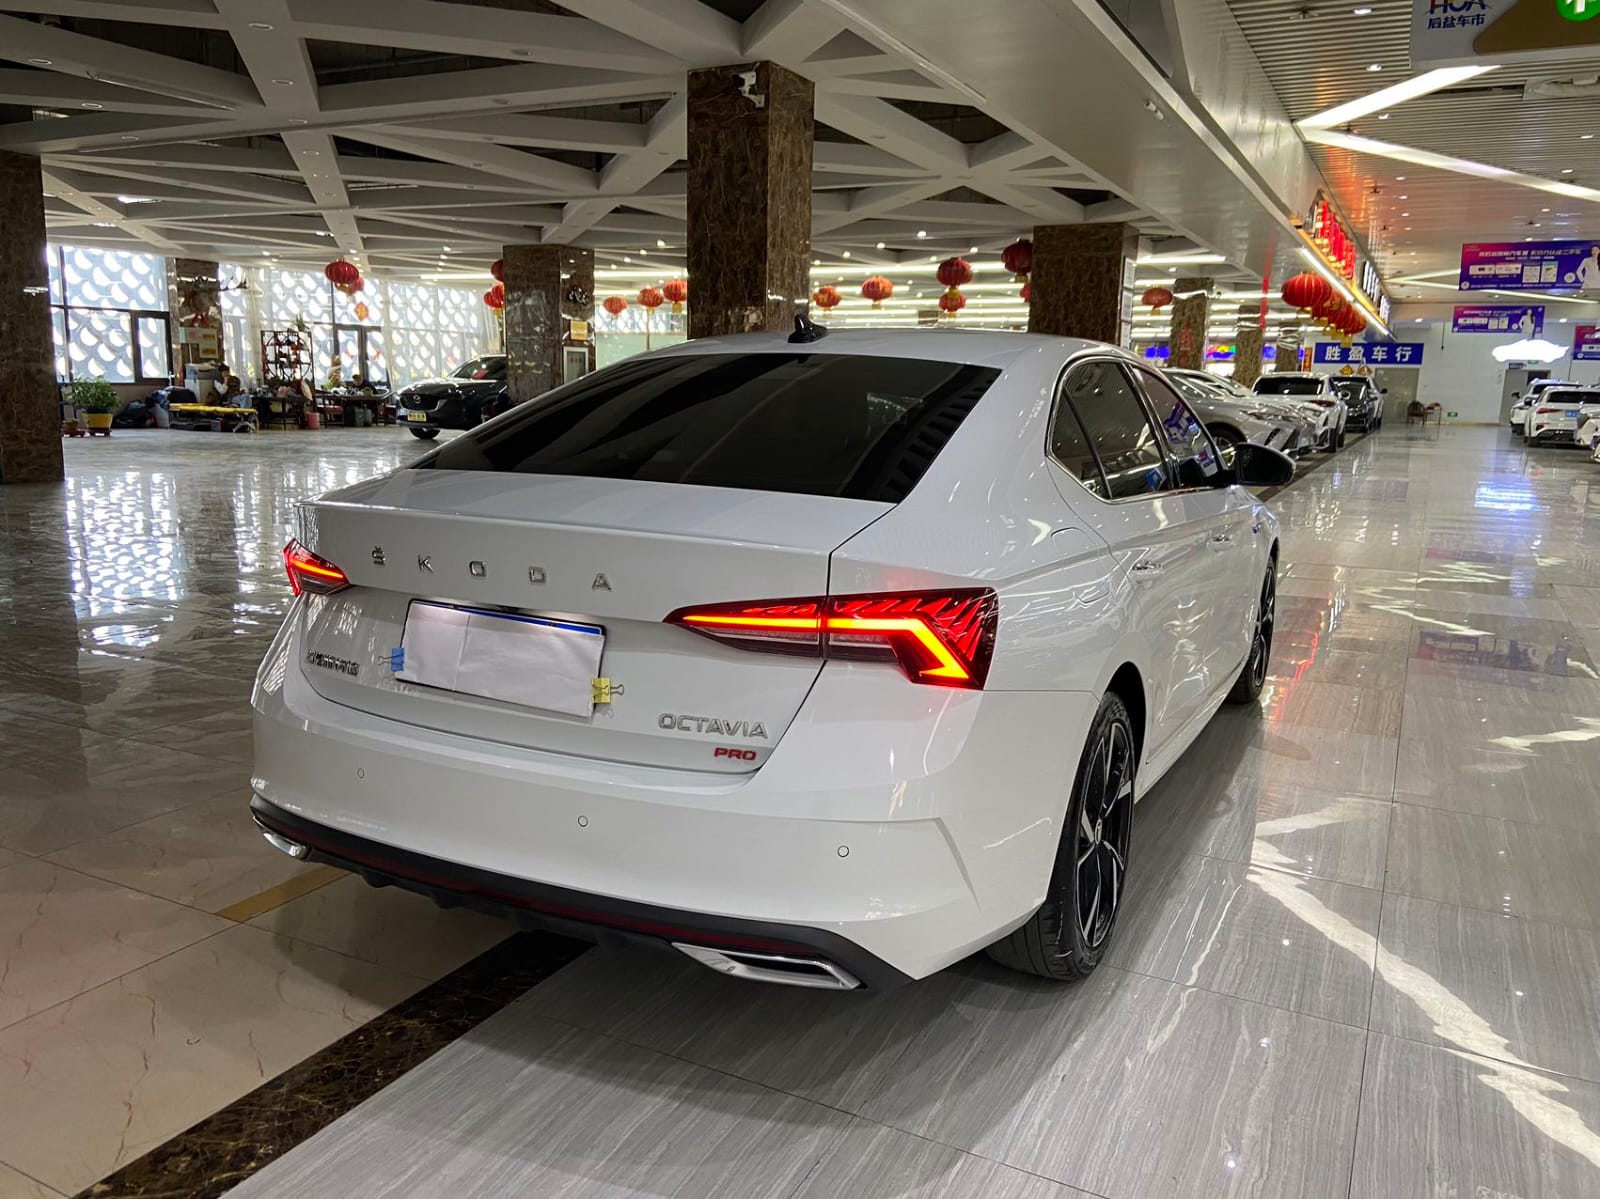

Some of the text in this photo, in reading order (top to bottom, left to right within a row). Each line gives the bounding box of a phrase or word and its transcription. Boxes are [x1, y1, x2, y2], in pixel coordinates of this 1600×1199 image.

[1428, 14, 1486, 29] 后盐车市
[1325, 346, 1412, 361] 胜盈车行
[371, 546, 613, 591] ŠKODA
[658, 713, 768, 739] OCTAVIA
[714, 747, 757, 761] PRO
